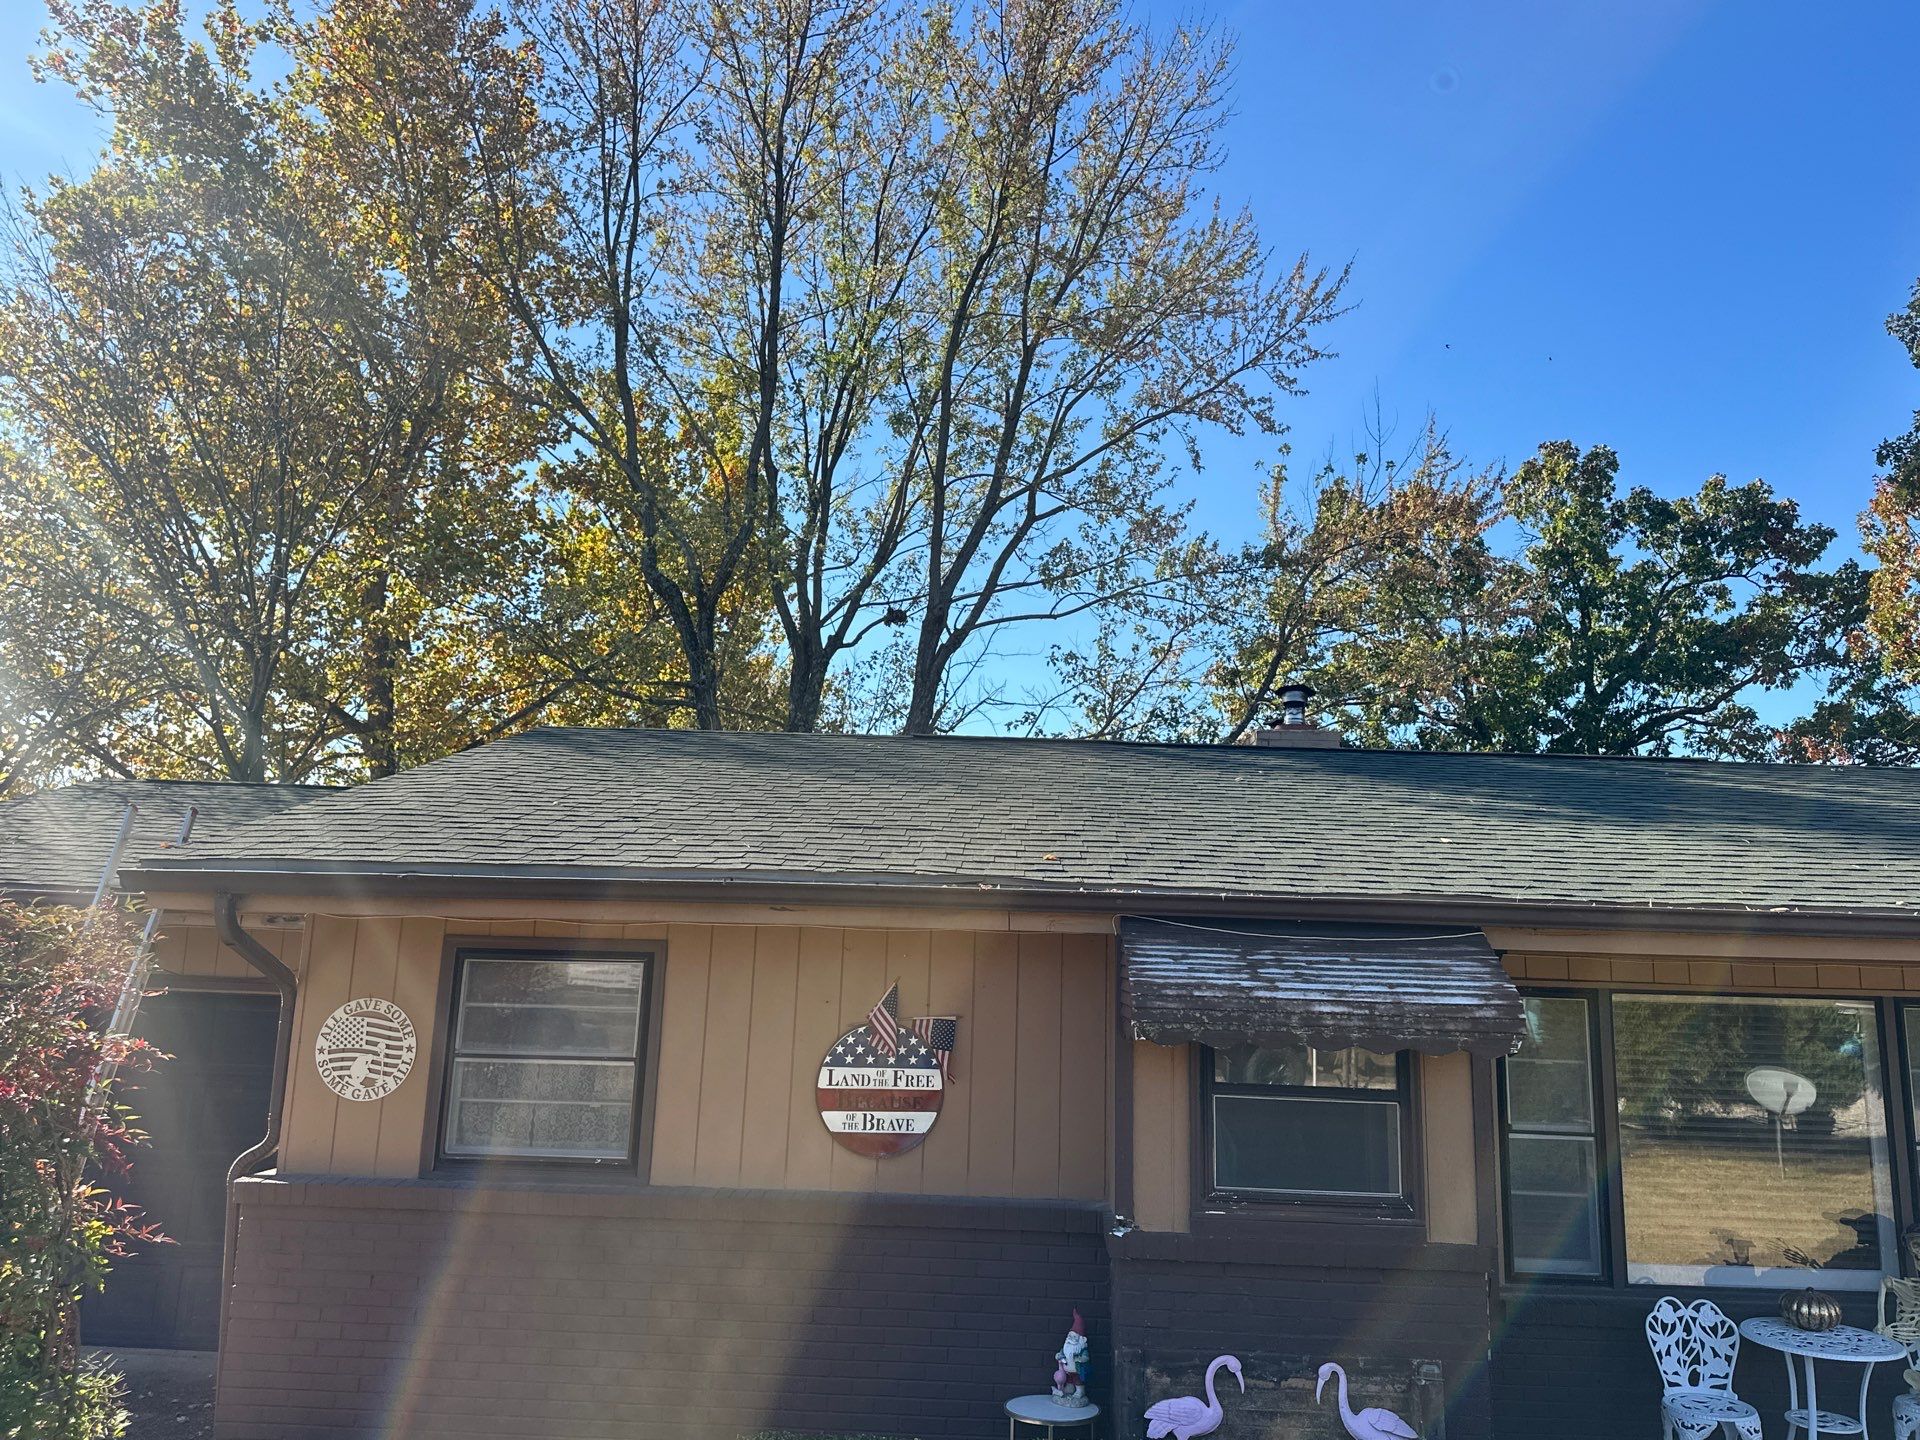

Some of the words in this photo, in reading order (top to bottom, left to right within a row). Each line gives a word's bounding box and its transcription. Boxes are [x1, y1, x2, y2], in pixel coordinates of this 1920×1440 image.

[320, 1015, 342, 1042] ALL
[343, 999, 382, 1015] GAVE
[384, 1004, 414, 1040] SOME
[318, 1059, 348, 1096] SOME
[351, 1082, 391, 1100] GAVE
[392, 1057, 413, 1086] ALL
[826, 1068, 871, 1087] LAND
[873, 1079, 889, 1087] THE
[876, 1070, 886, 1078] OF
[891, 1069, 935, 1088] FREE
[842, 1122, 859, 1131] THE
[845, 1113, 857, 1122] OF
[861, 1113, 915, 1132] BRAVE
